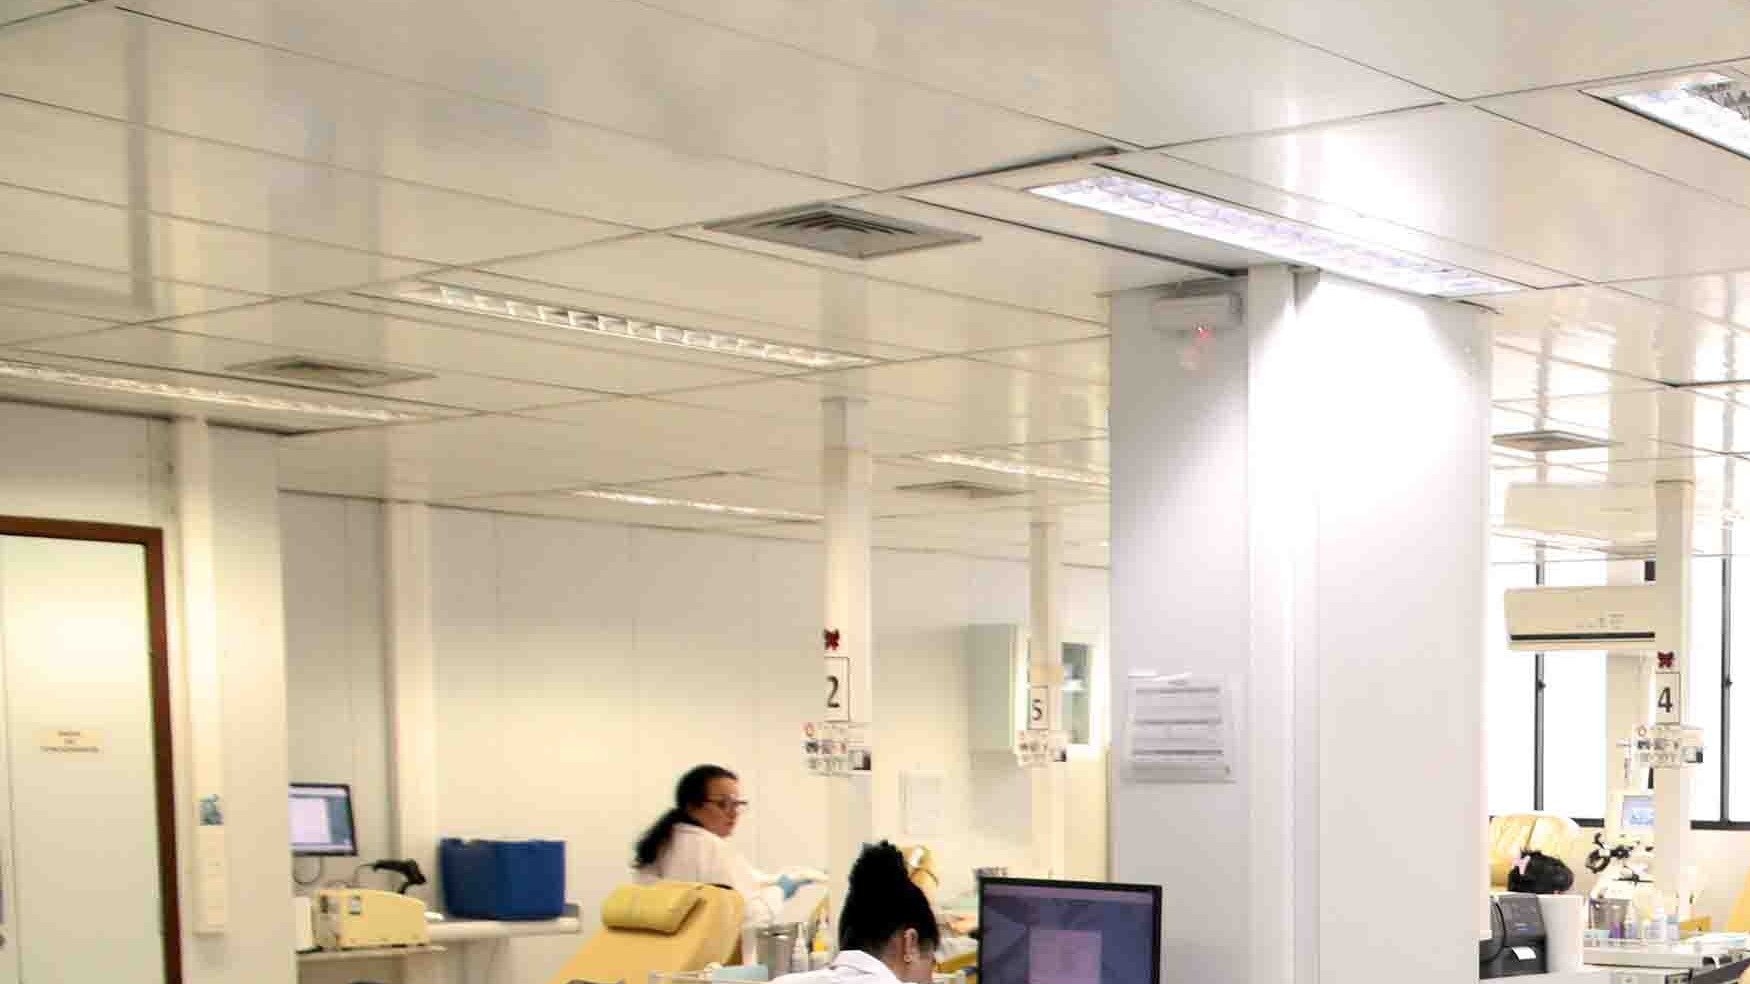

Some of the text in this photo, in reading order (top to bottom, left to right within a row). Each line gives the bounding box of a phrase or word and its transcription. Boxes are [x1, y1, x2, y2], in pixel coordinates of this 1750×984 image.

[826, 675, 840, 708] 2
[1657, 686, 1673, 713] 4
[1031, 698, 1042, 721] 5
